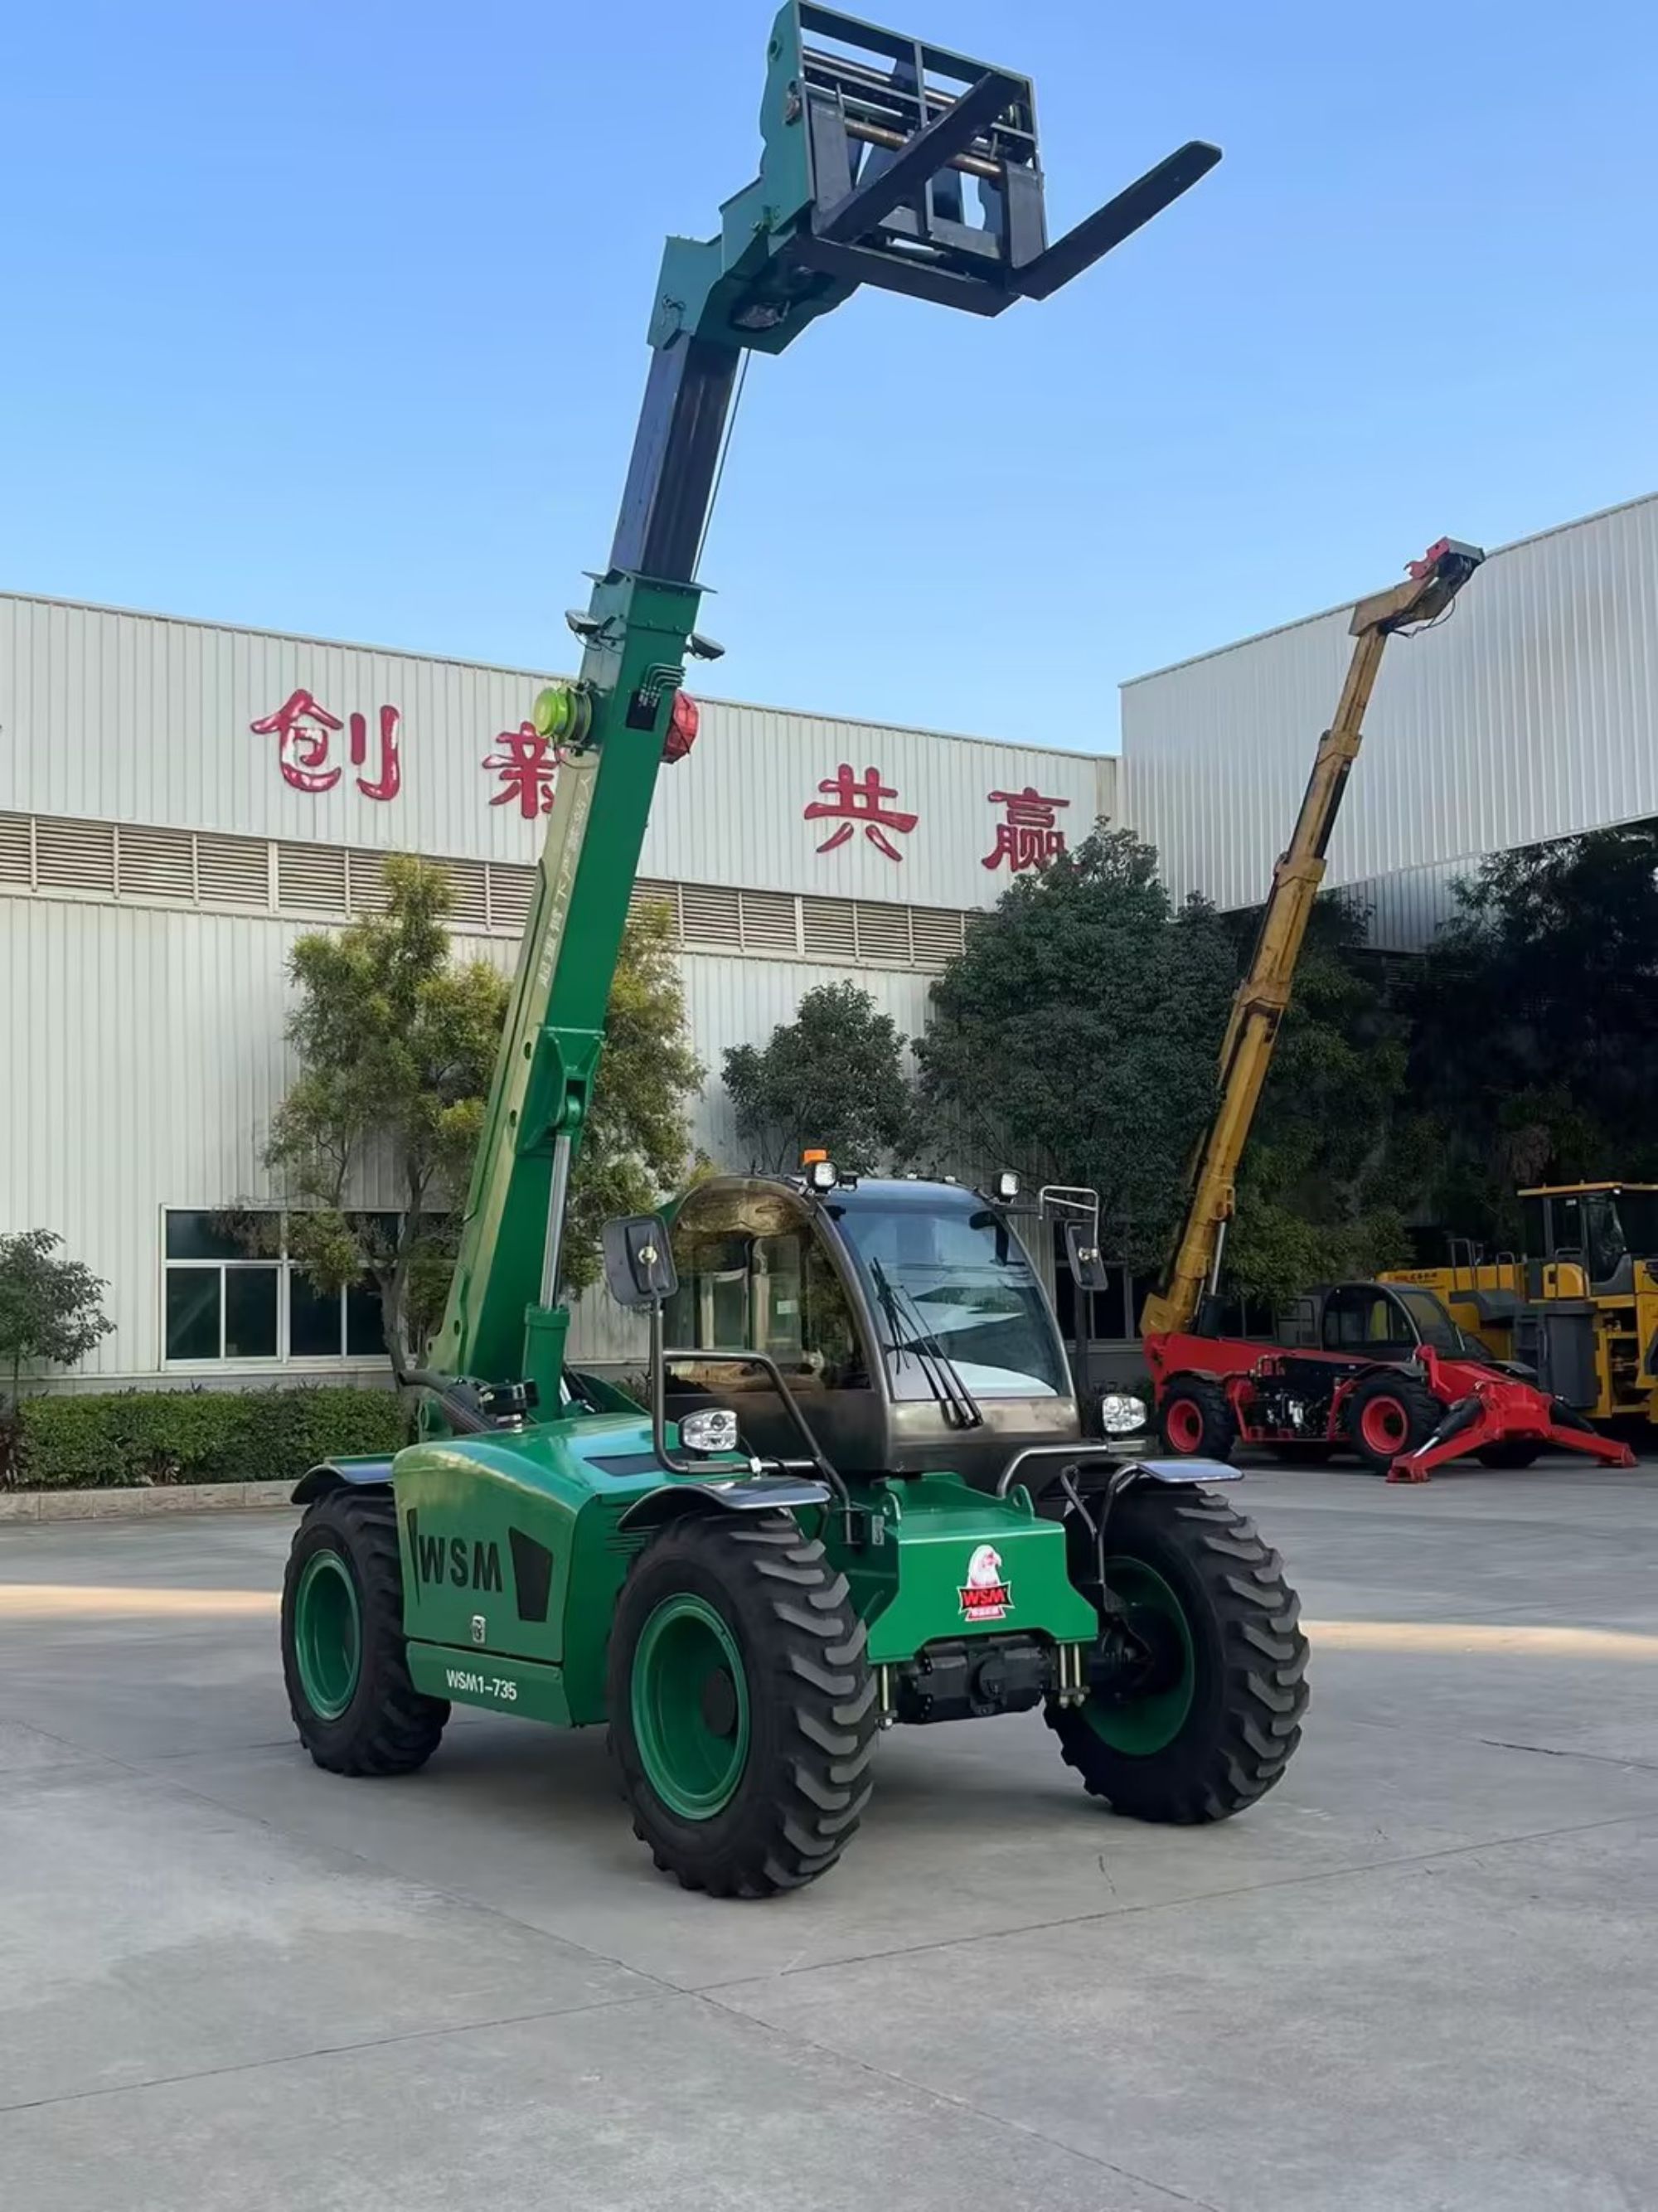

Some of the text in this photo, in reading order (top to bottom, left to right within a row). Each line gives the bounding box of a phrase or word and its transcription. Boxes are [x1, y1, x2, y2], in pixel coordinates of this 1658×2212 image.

[418, 1534, 503, 1593] WSM
[963, 1588, 1006, 1606] WSM
[445, 1669, 517, 1700] WSM1-735
